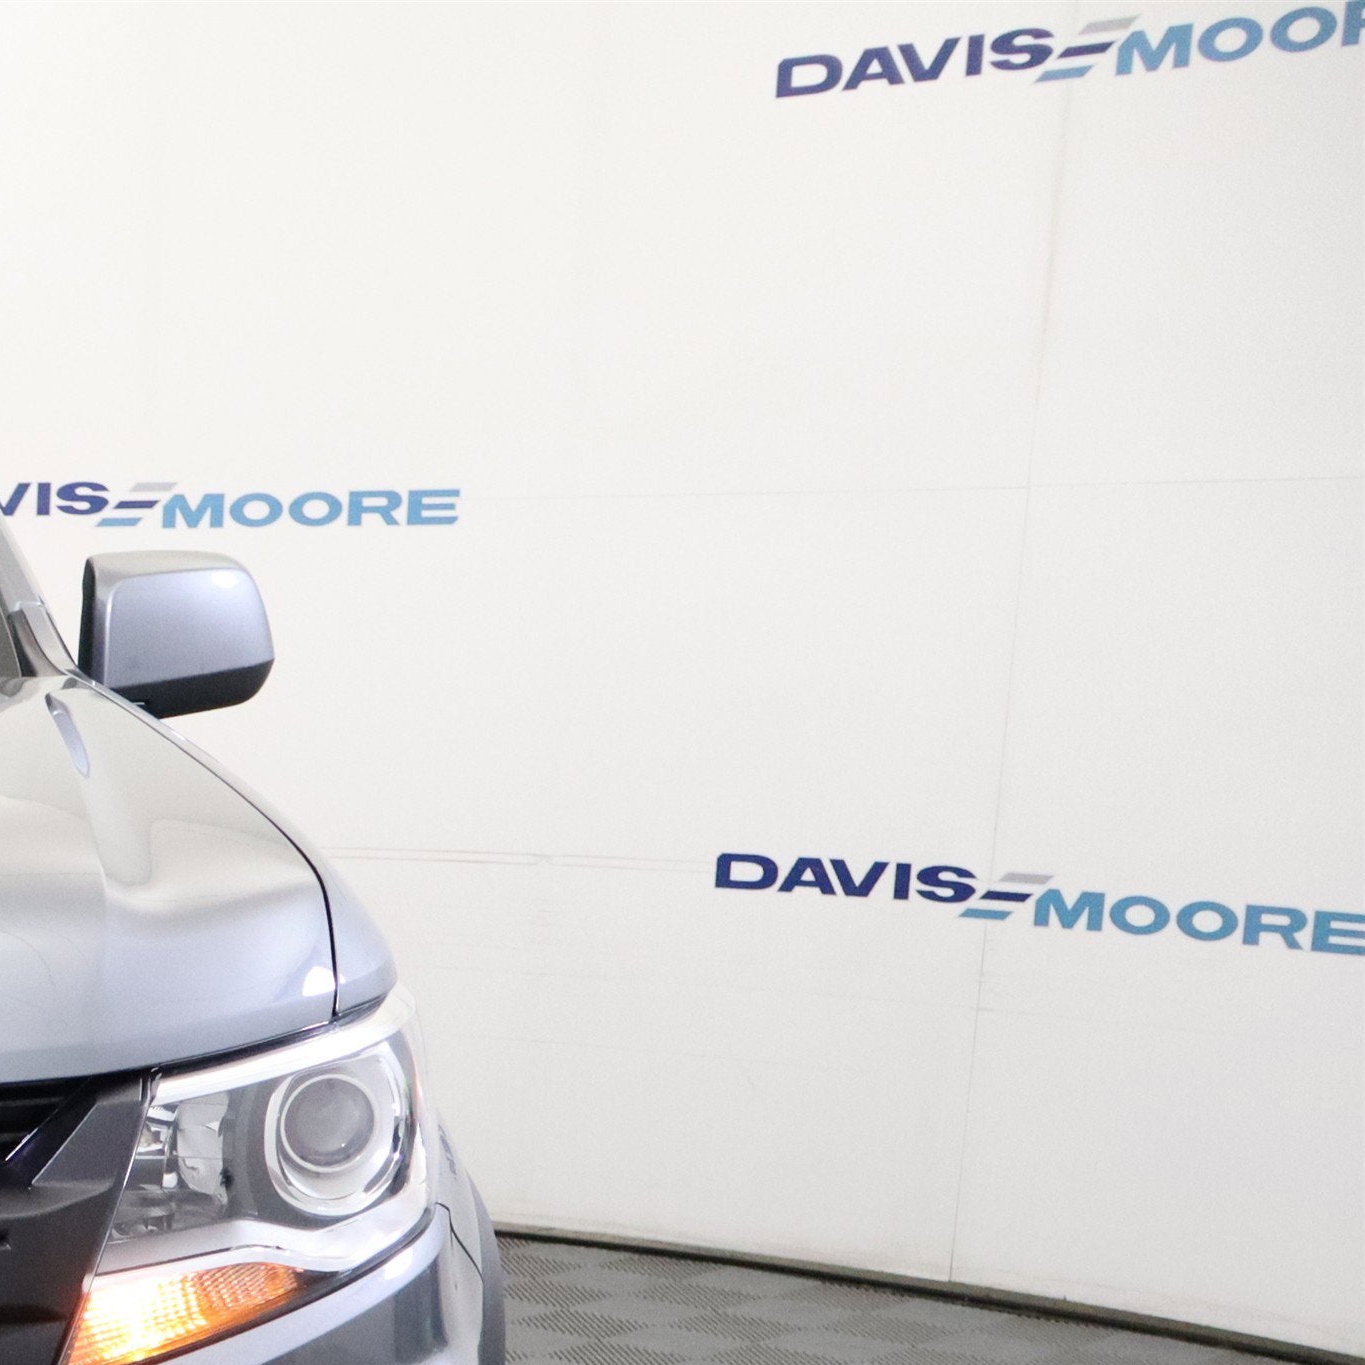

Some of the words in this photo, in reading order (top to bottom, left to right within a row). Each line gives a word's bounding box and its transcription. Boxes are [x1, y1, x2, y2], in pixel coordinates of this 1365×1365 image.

[775, 28, 1055, 98] DAVIS
[161, 489, 460, 529] MOORE
[715, 852, 977, 904] DAVIS
[1033, 888, 1365, 957] MOORE
